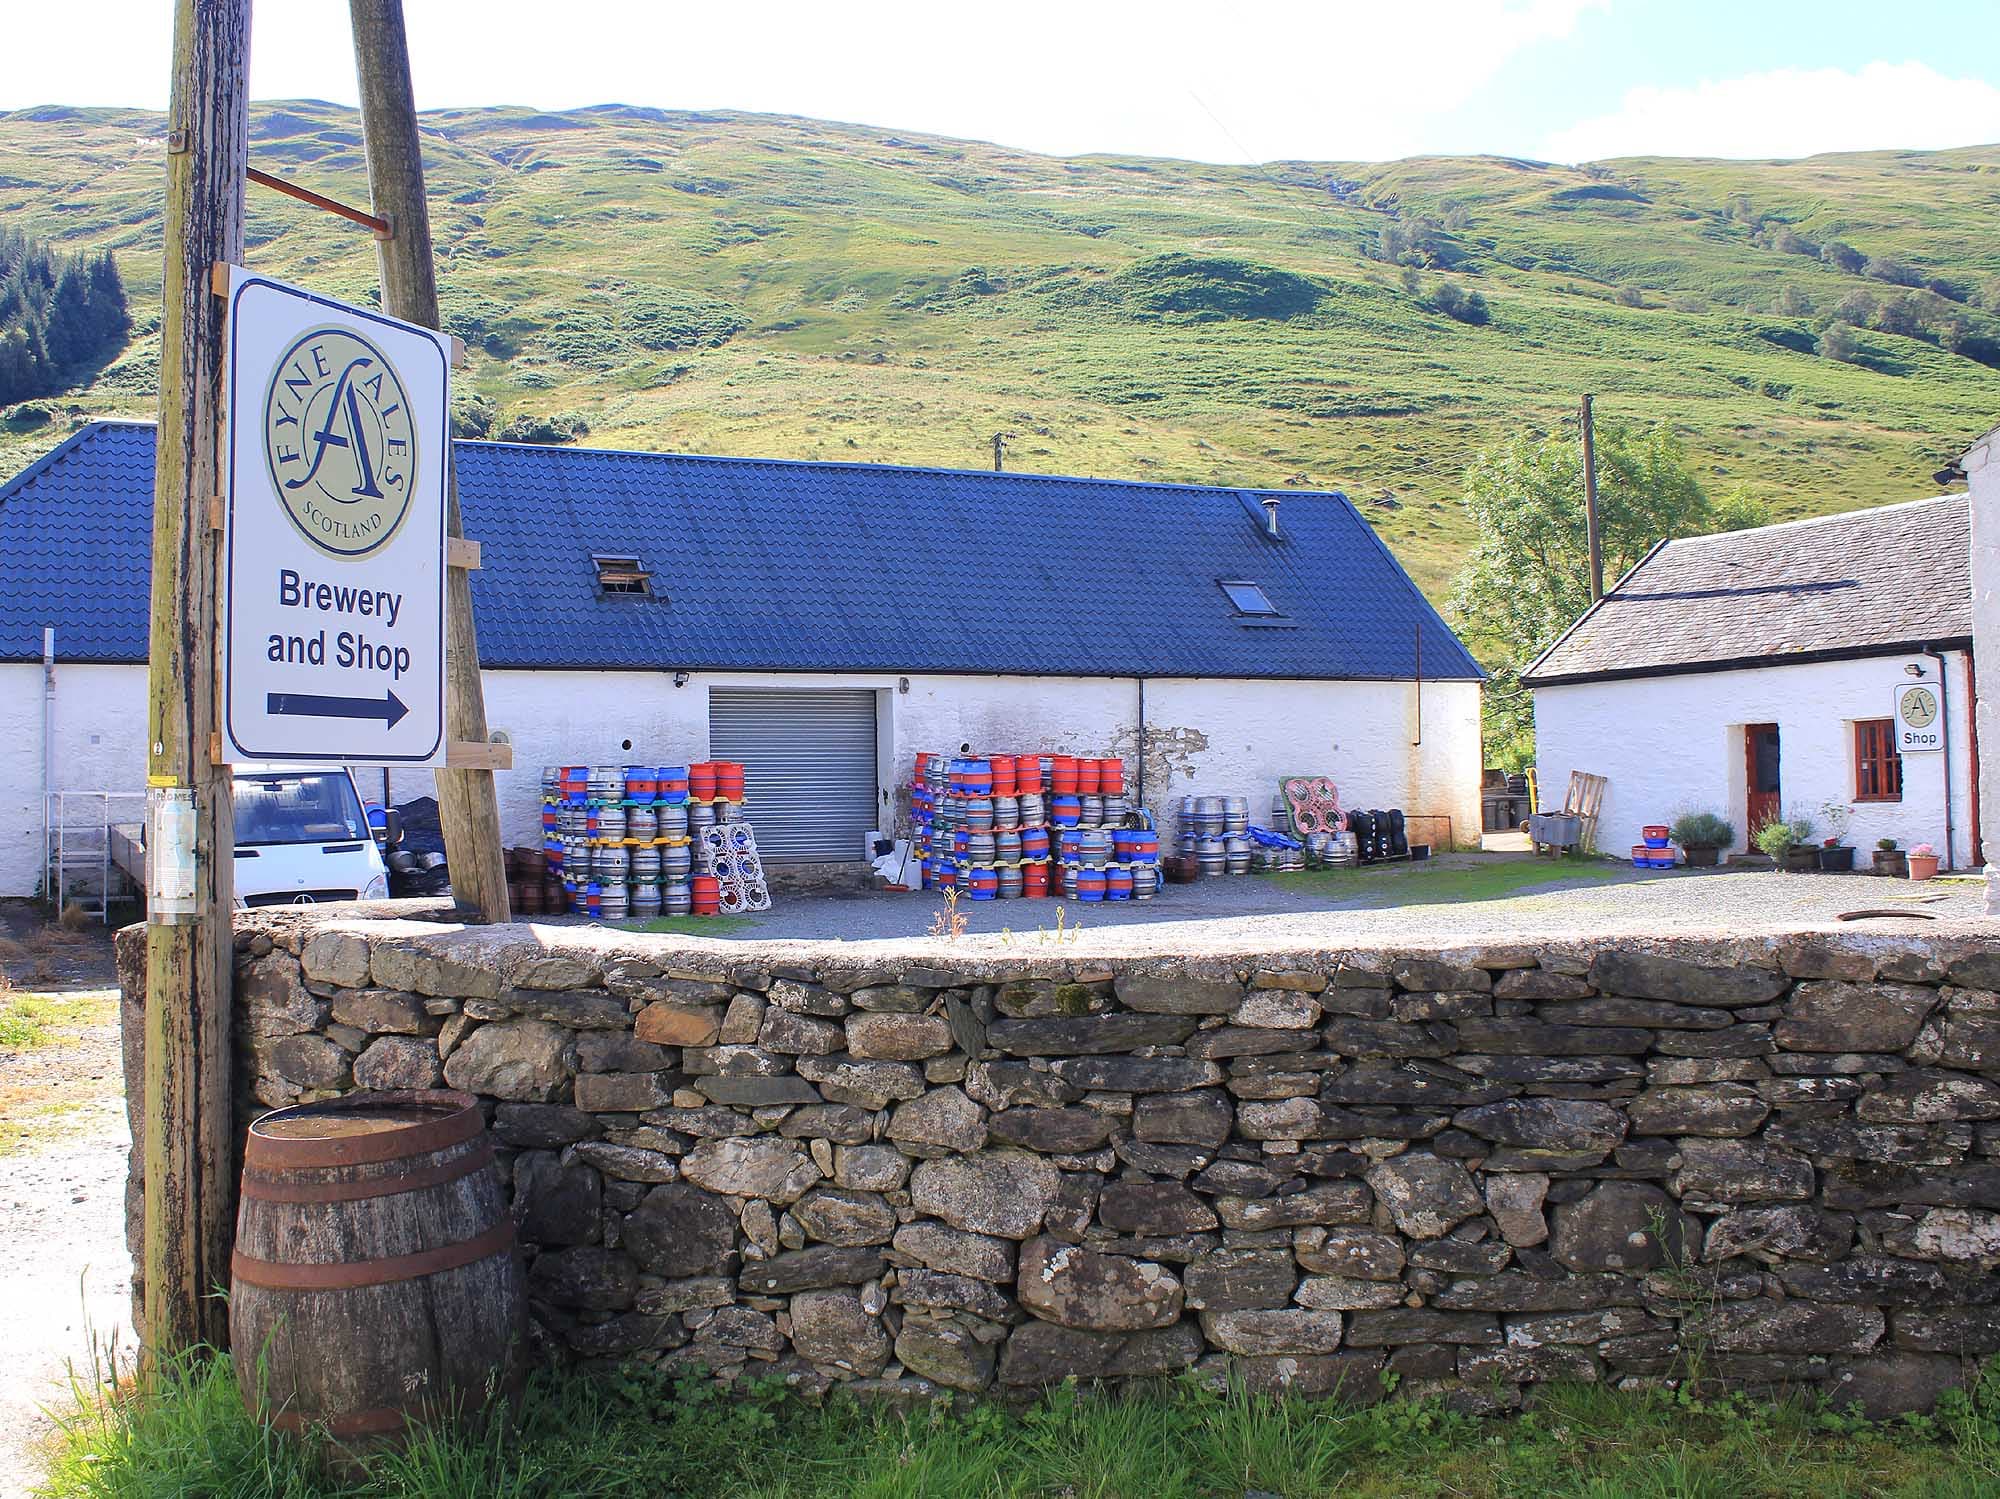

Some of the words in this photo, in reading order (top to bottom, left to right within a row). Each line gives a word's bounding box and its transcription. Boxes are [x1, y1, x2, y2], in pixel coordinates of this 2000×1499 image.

[276, 345, 332, 466] FYNE
[362, 373, 407, 492] ALES
[303, 501, 382, 538] SCOTLAND
[280, 569, 402, 627] Brewery
[267, 630, 325, 665] and
[336, 631, 410, 680] Shop
[1904, 732, 1937, 746] Shop
